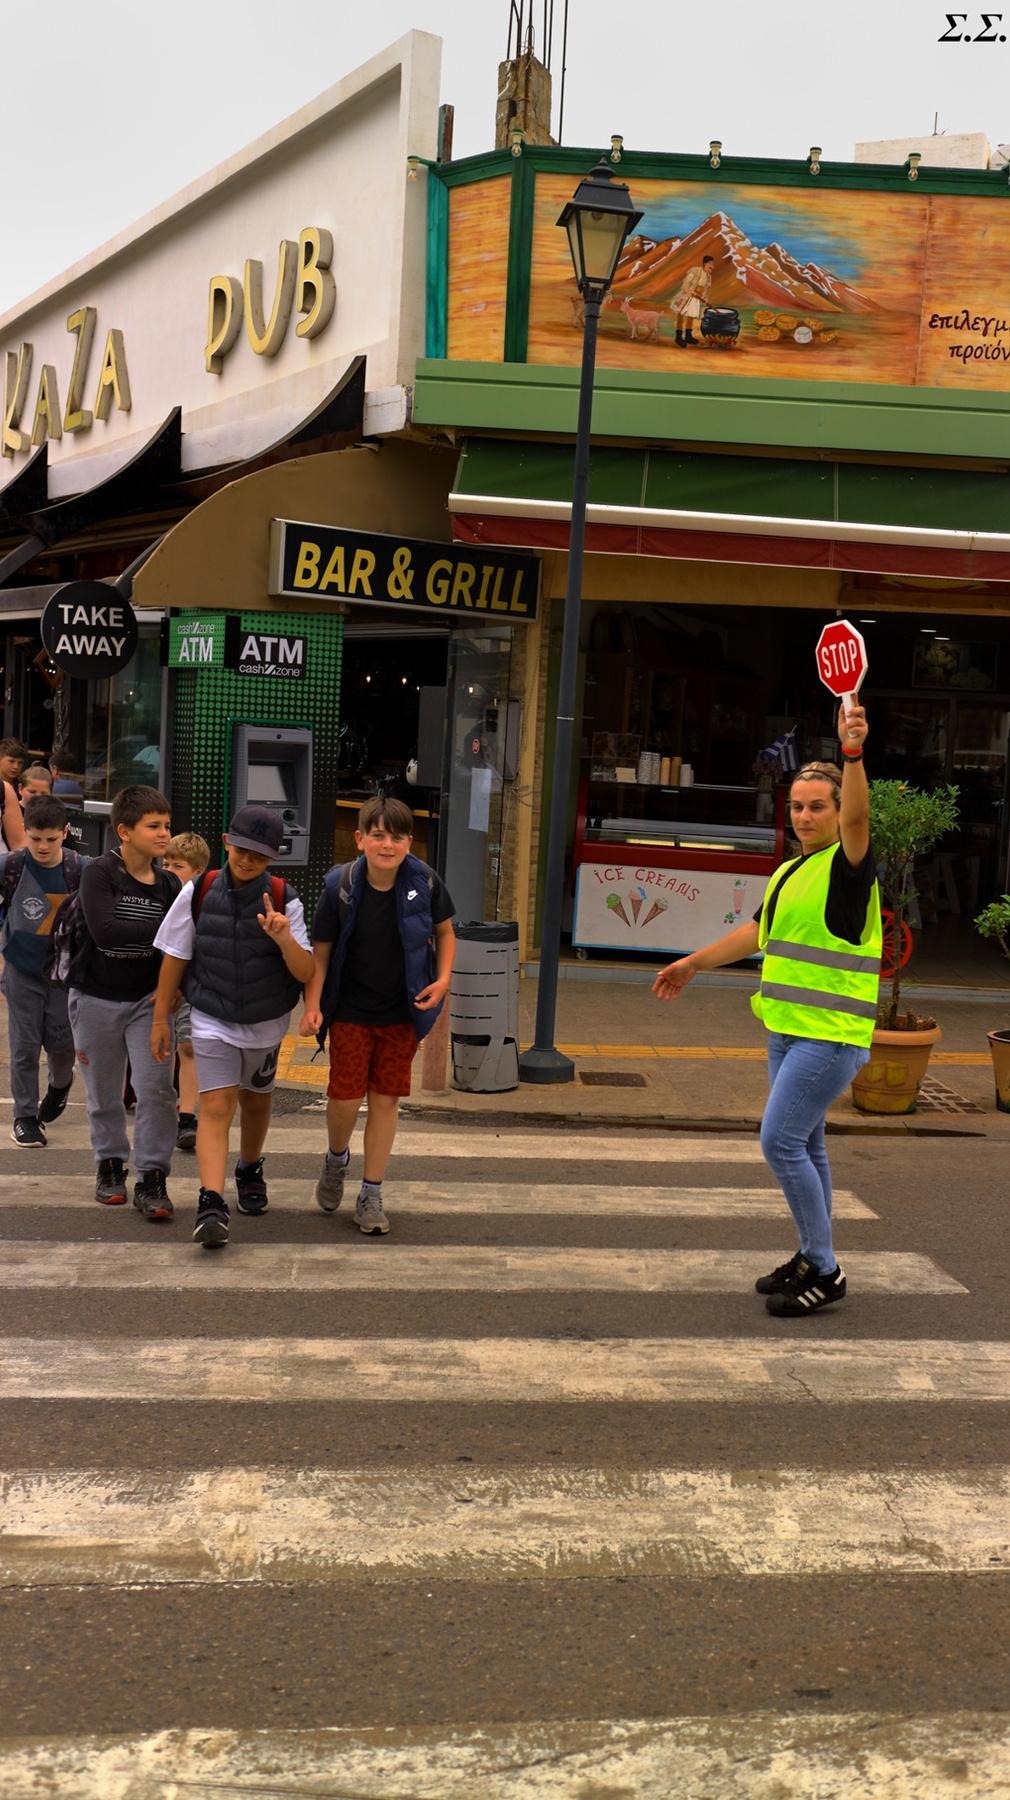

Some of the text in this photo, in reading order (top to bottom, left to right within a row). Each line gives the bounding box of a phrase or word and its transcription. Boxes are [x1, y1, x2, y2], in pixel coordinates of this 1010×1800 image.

[929, 309, 1010, 337] επιλεγμ
[2, 226, 337, 458] KAZA PUB
[293, 541, 528, 613] BAR & GRILL
[58, 604, 124, 628] TAKE
[55, 634, 126, 657] AWAY
[178, 637, 214, 662] ATM
[240, 635, 304, 665] ATM
[821, 639, 857, 679] STOP
[635, 868, 700, 902] CREAMS
